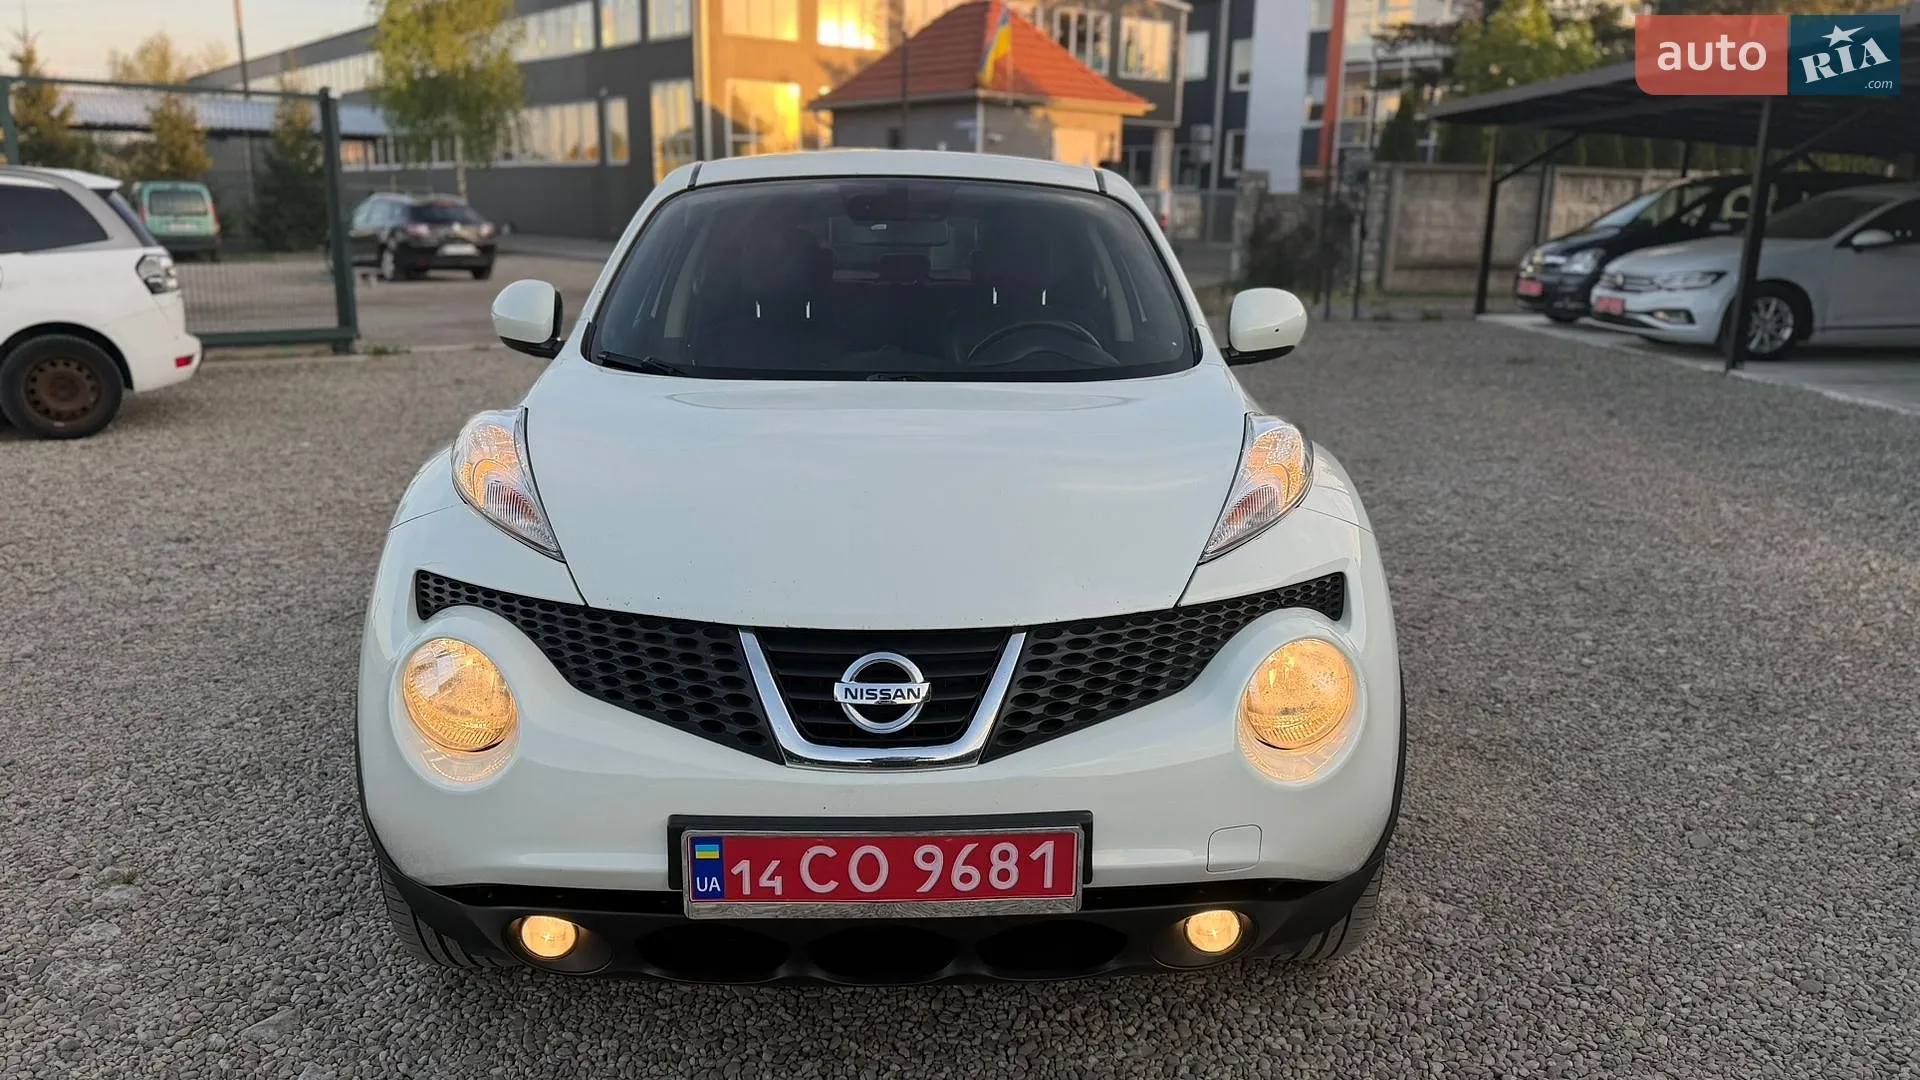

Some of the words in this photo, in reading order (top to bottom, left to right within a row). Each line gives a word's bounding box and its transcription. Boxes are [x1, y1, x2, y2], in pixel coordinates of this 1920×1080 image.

[844, 687, 921, 700] NISSAN
[730, 859, 783, 896] 14
[800, 845, 889, 893] CO
[913, 840, 1055, 893] 9681
[696, 876, 721, 892] UA
